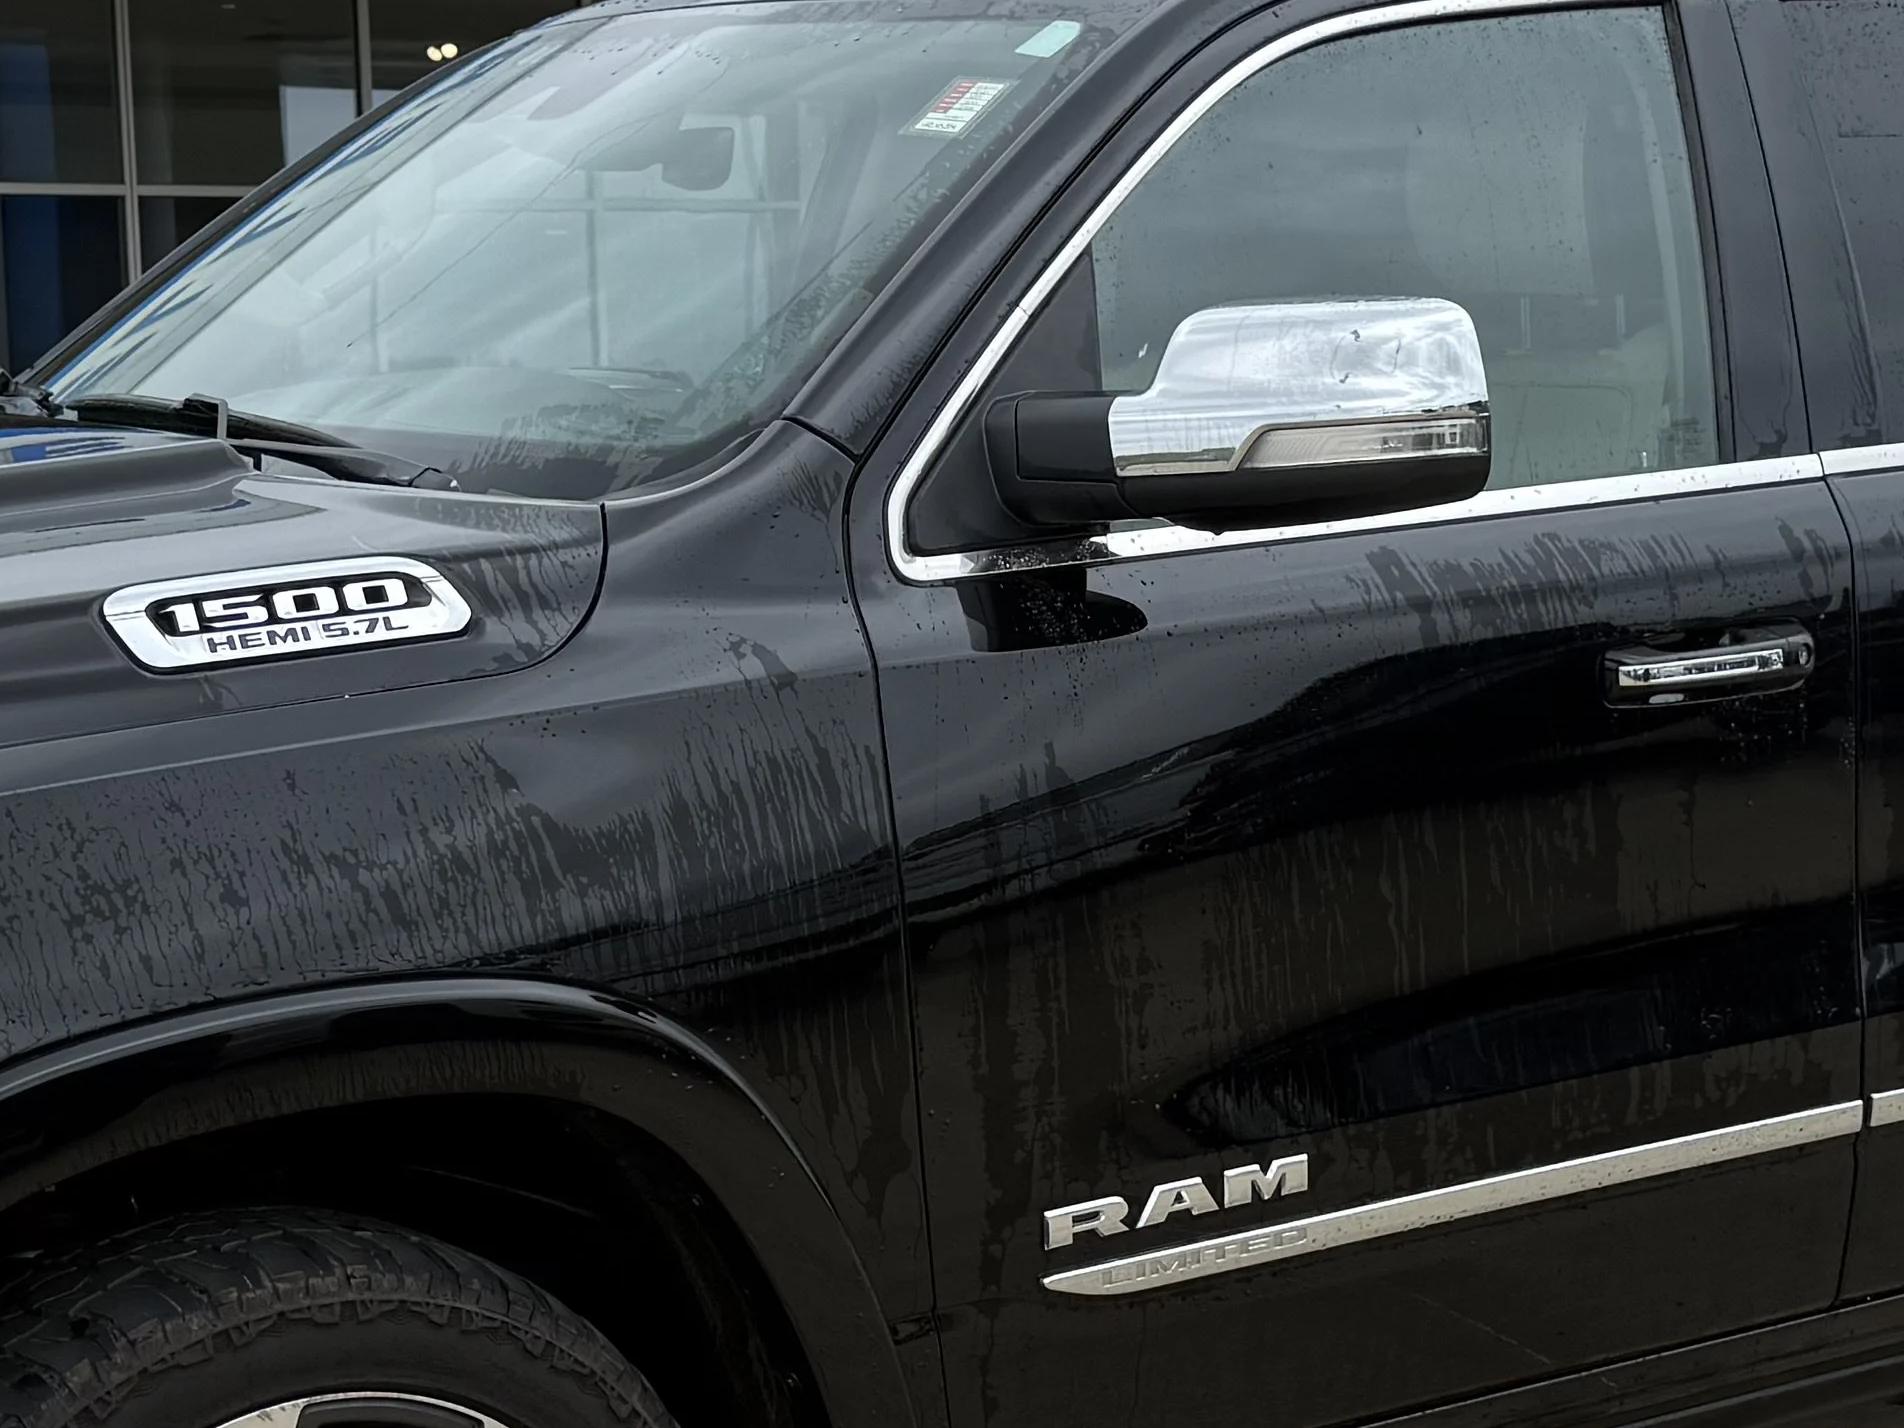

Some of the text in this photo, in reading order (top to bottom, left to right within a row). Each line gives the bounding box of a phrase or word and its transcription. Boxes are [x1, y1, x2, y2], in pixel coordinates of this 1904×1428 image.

[160, 578, 408, 632] 1500
[208, 616, 410, 654] HEMI 5.7L
[1044, 1153, 1308, 1251] RAM
[1102, 1227, 1309, 1288] LIMITED
